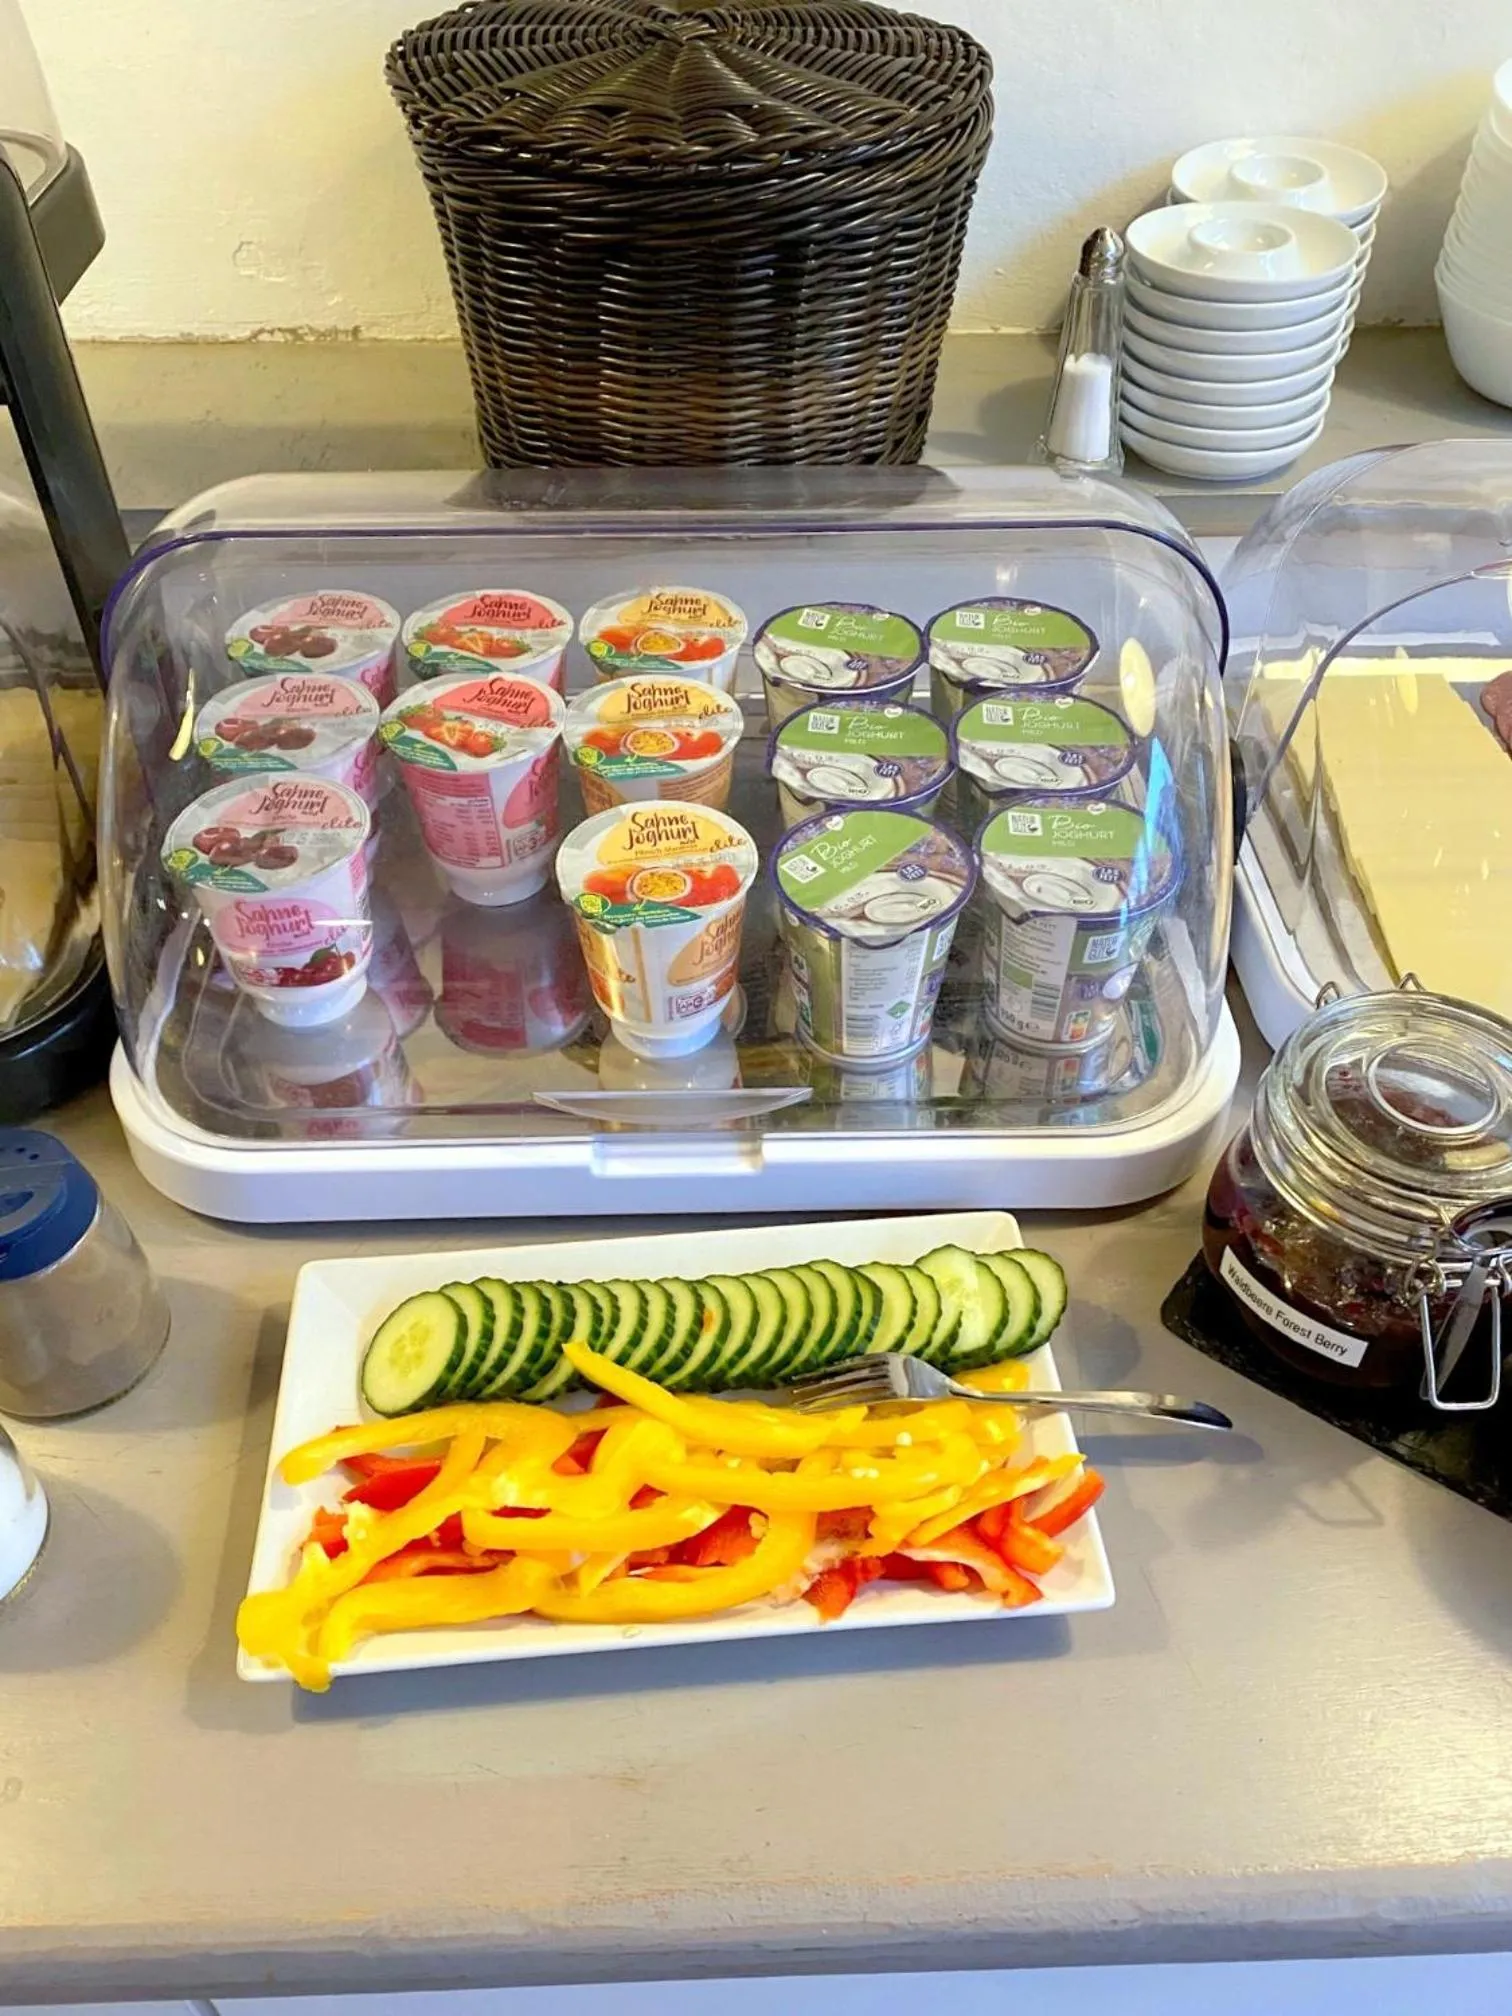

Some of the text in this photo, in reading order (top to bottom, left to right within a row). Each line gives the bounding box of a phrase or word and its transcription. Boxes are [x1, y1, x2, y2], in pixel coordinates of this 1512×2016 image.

[280, 676, 331, 695] Sahne
[488, 676, 534, 699] Sahne
[630, 682, 683, 698] Sahne
[261, 688, 336, 708] Joghurt
[462, 688, 537, 715] Joghurt
[626, 689, 691, 714] Joghurt
[271, 781, 325, 799] Sahne
[249, 795, 328, 815] Joghurt
[321, 816, 363, 829] elite
[631, 811, 690, 832] Sahne
[1047, 814, 1098, 830] Bio
[622, 821, 700, 850] Joghurt
[709, 835, 747, 853] elite
[1052, 829, 1115, 841] JOGHURT
[234, 898, 302, 920] Sahne
[235, 908, 314, 941] Joghurt
[1227, 1263, 1349, 1356] Waldbeere Forest Berry
